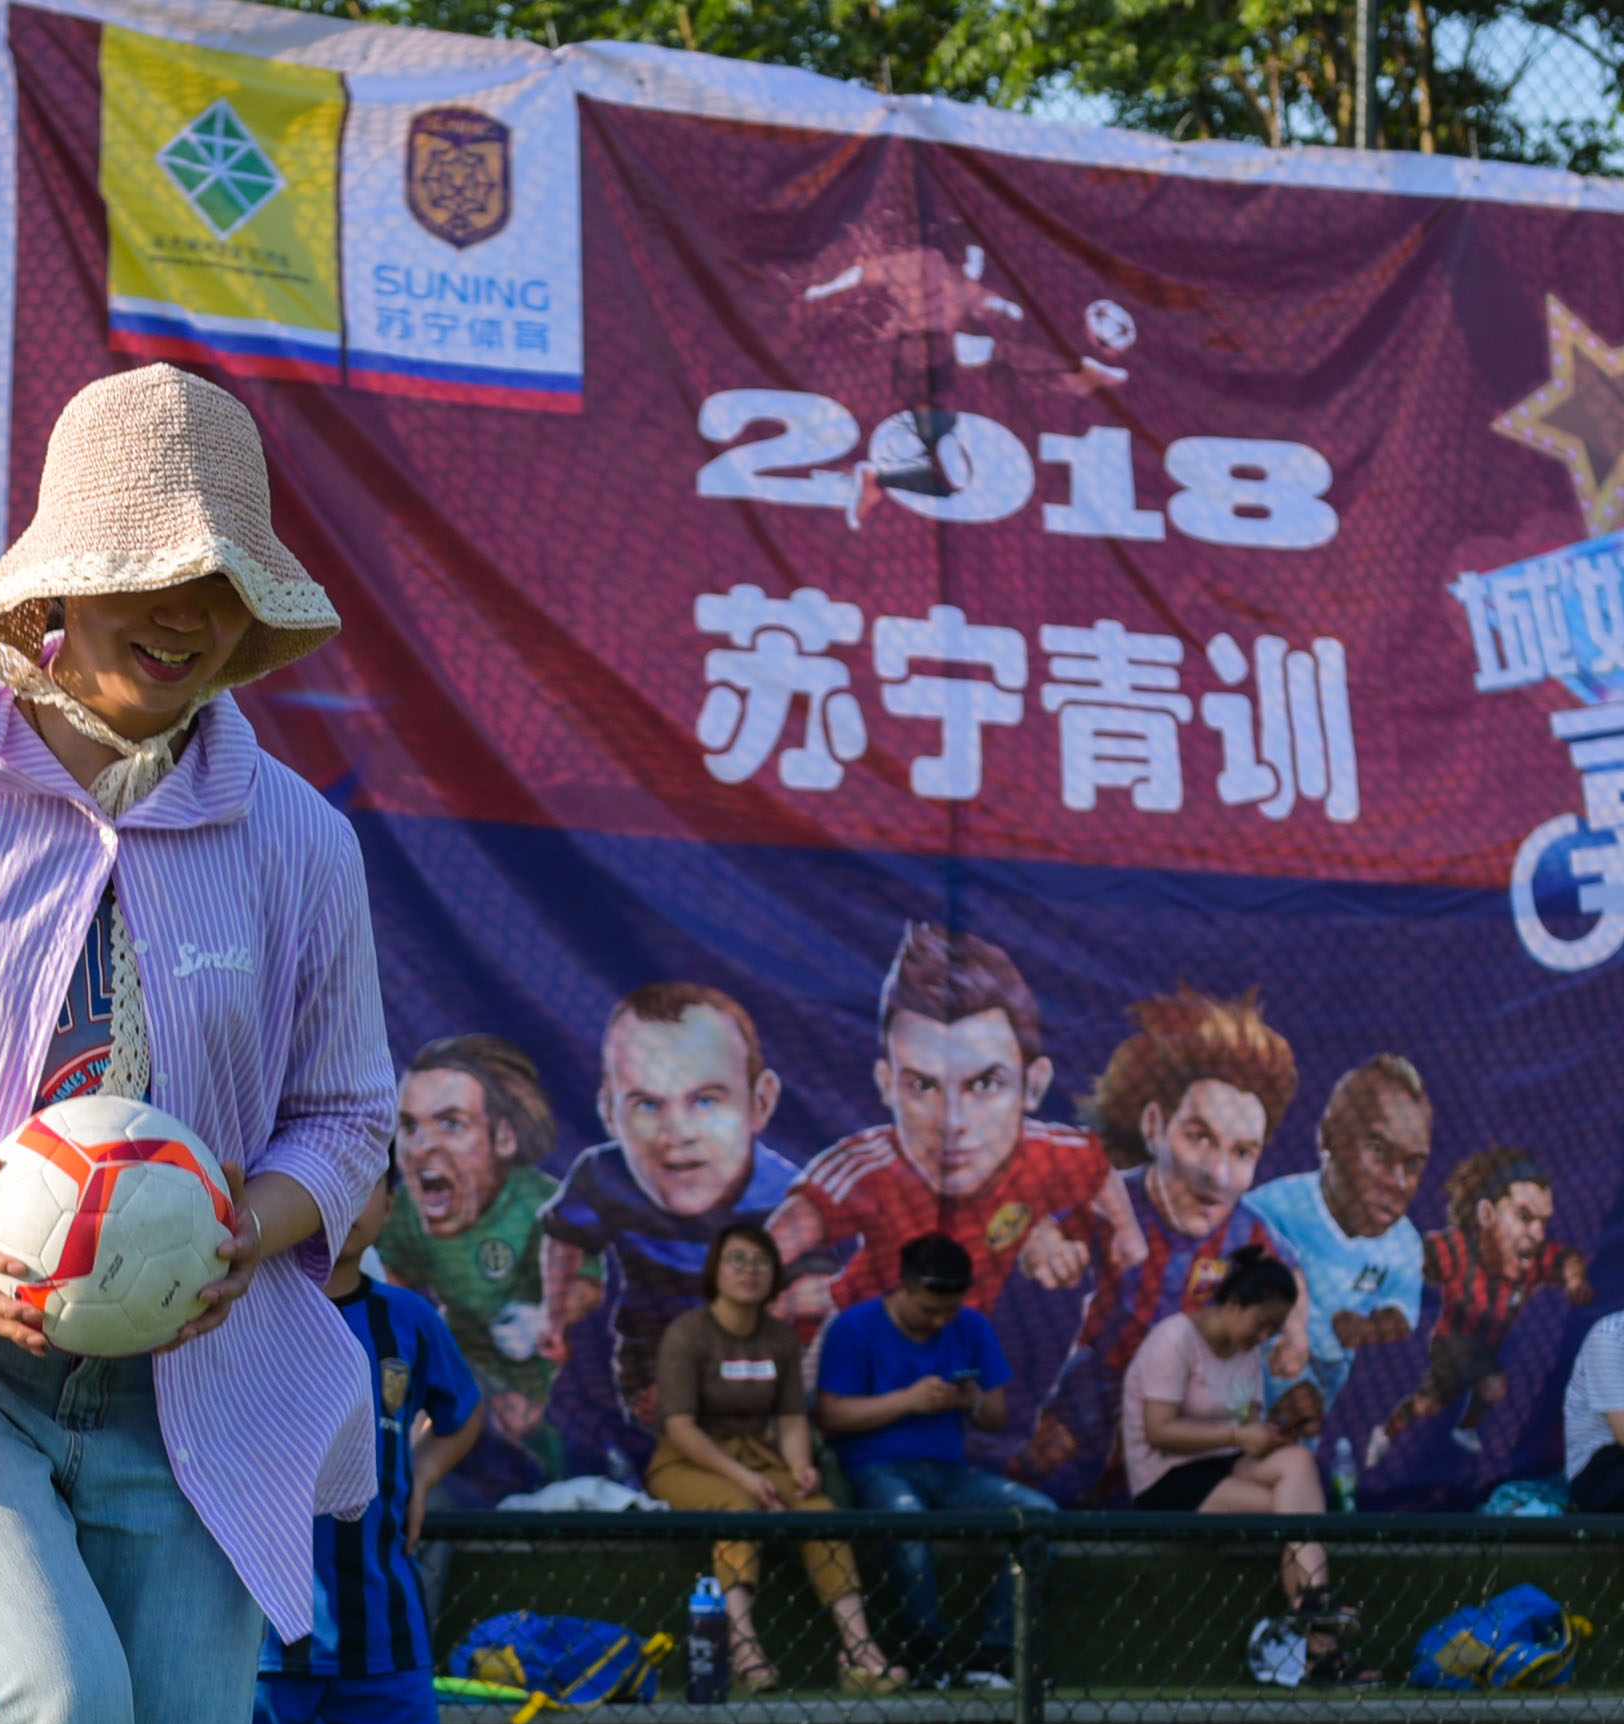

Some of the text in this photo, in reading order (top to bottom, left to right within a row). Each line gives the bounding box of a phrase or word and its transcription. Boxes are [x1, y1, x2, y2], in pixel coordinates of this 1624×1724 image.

[373, 264, 550, 312] SUNING
[695, 387, 1340, 551] 2018
[693, 583, 1360, 823] 苏宁青训
